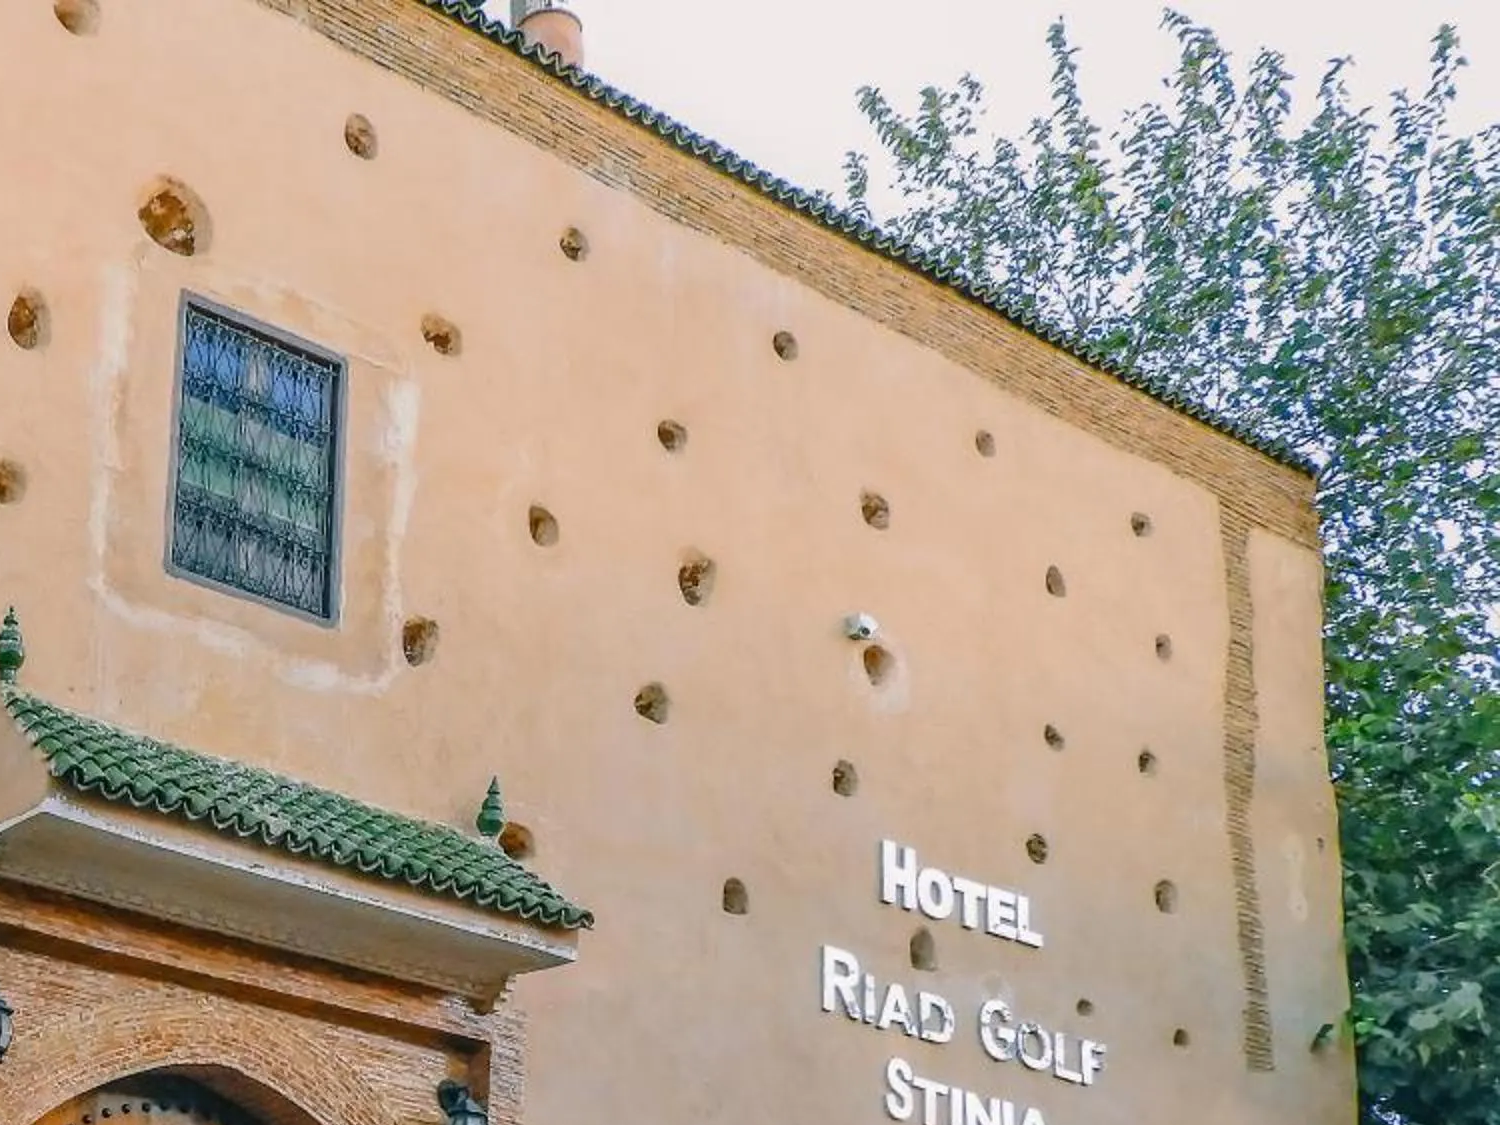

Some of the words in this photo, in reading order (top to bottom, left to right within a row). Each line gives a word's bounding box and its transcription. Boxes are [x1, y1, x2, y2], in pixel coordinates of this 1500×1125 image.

[880, 839, 1044, 948] HOTEL
[821, 945, 955, 1044] RIAD
[979, 999, 1107, 1085] GOLF
